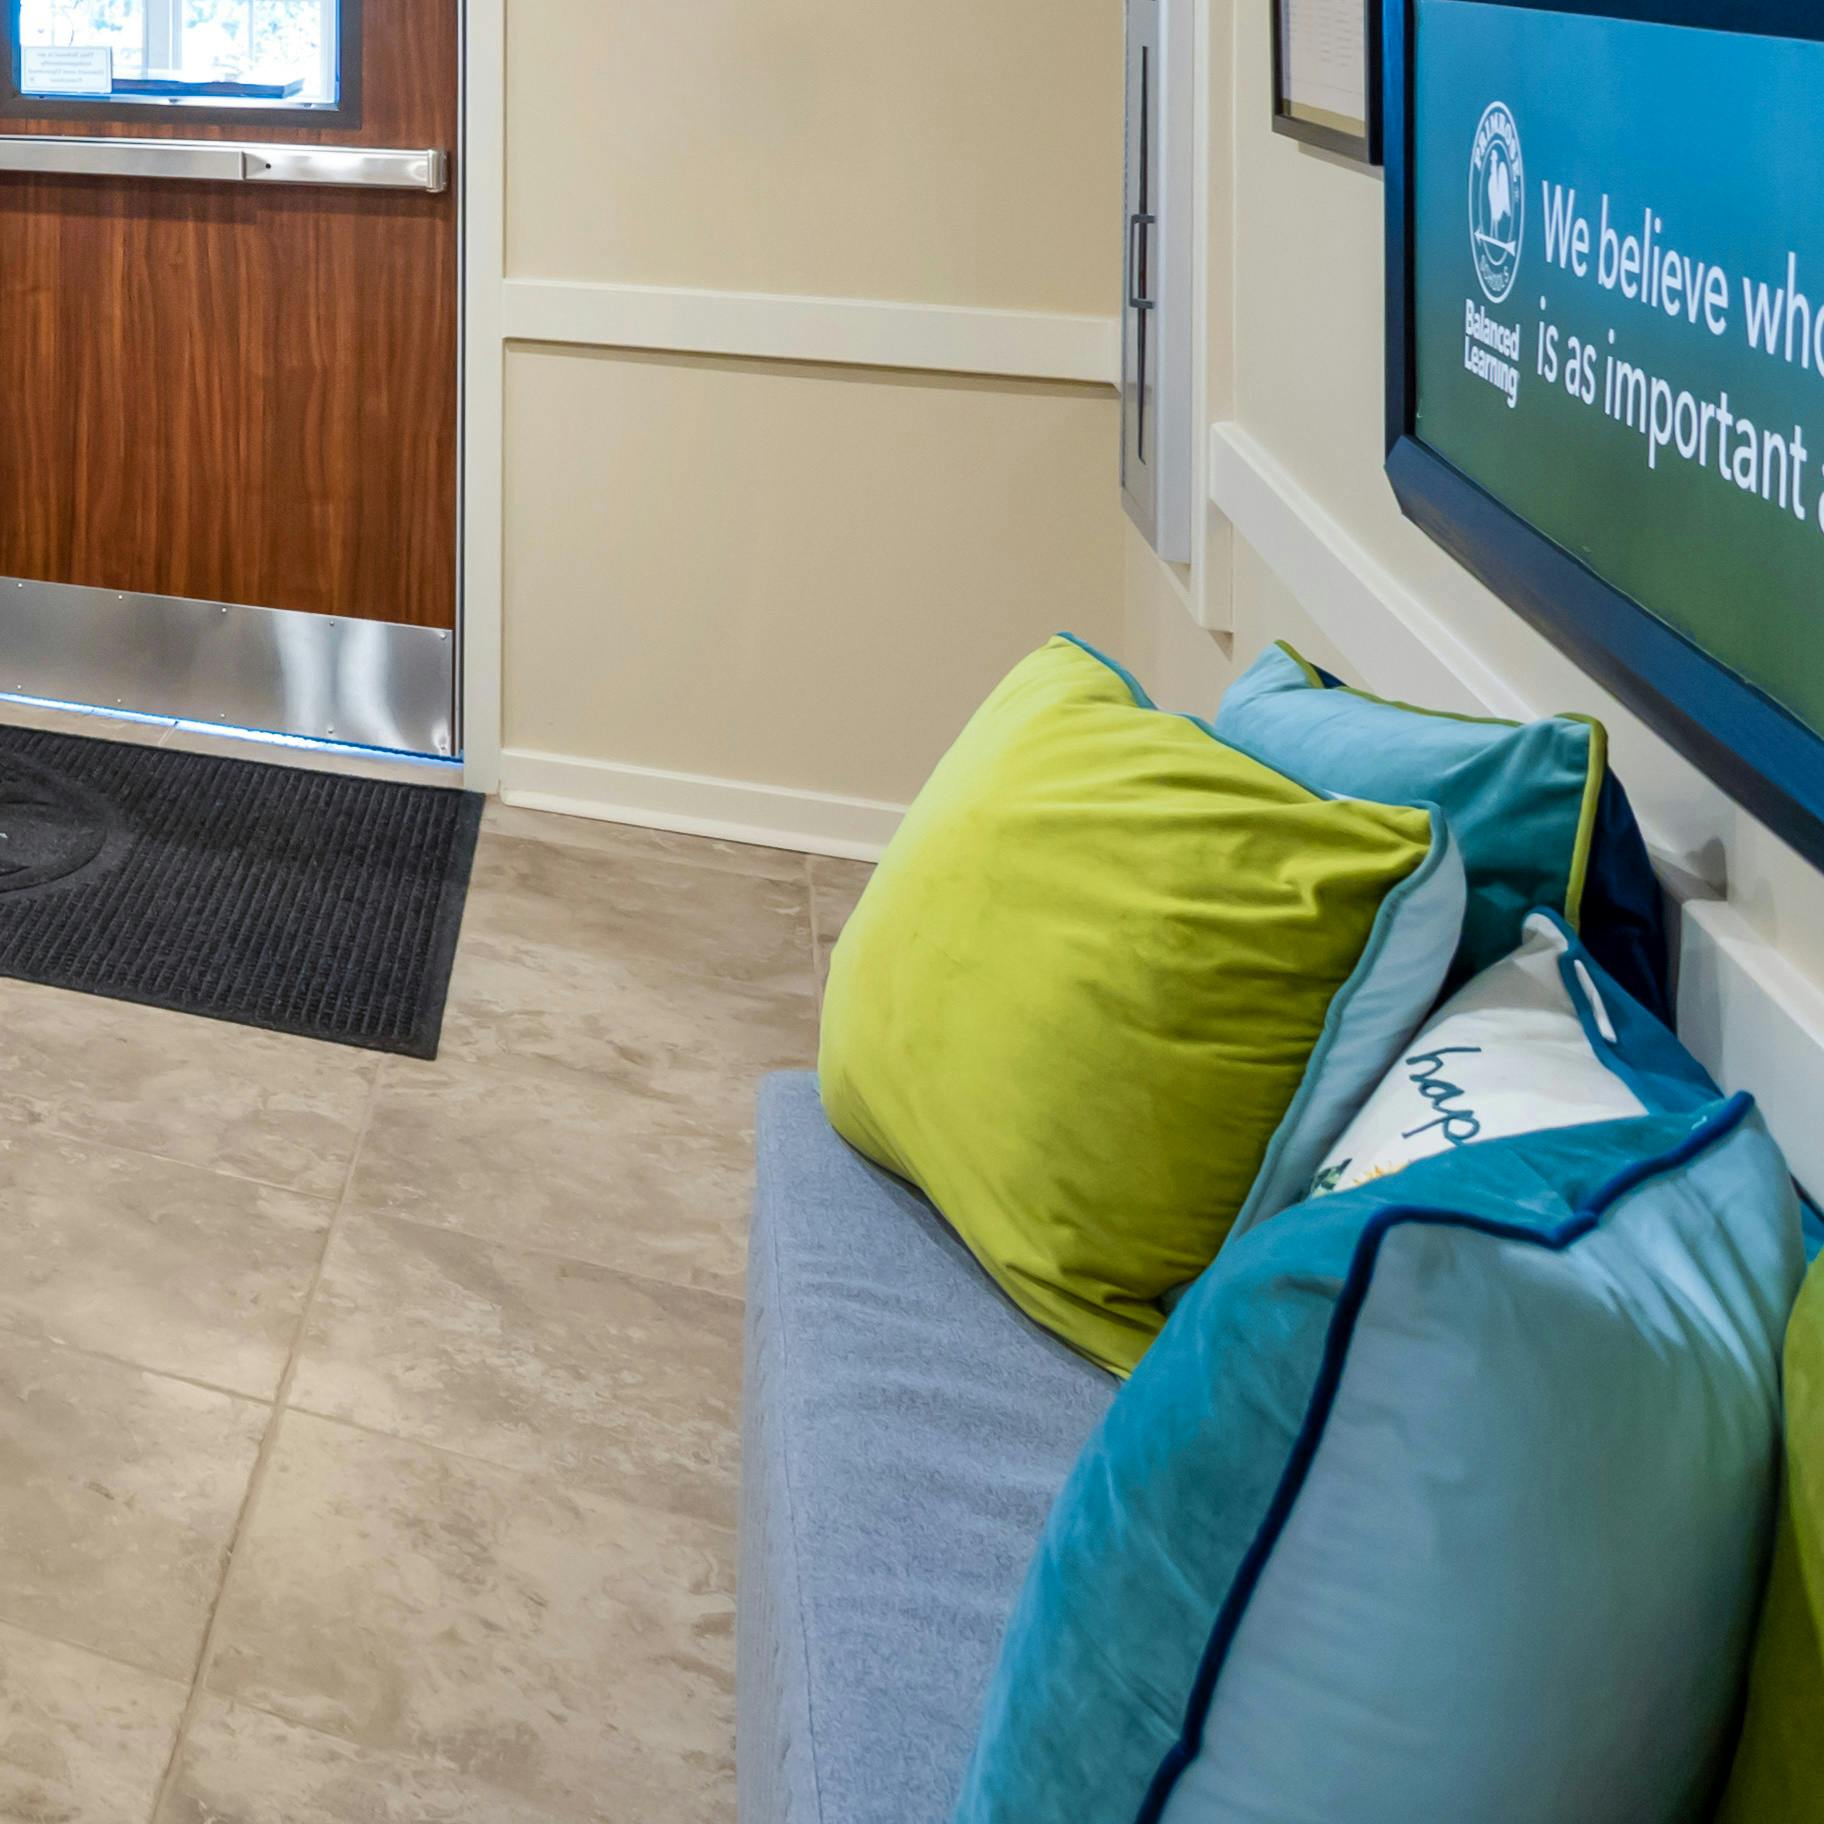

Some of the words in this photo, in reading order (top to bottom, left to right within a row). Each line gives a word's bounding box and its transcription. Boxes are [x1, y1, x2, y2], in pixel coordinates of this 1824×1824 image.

[1541, 179, 1590, 277] We
[1597, 193, 1730, 336] believe
[1463, 335, 1520, 410] Learning
[1464, 297, 1520, 362] Balanced
[1536, 295, 1560, 383] is
[1565, 336, 1597, 406] as
[1604, 328, 1807, 521] important
